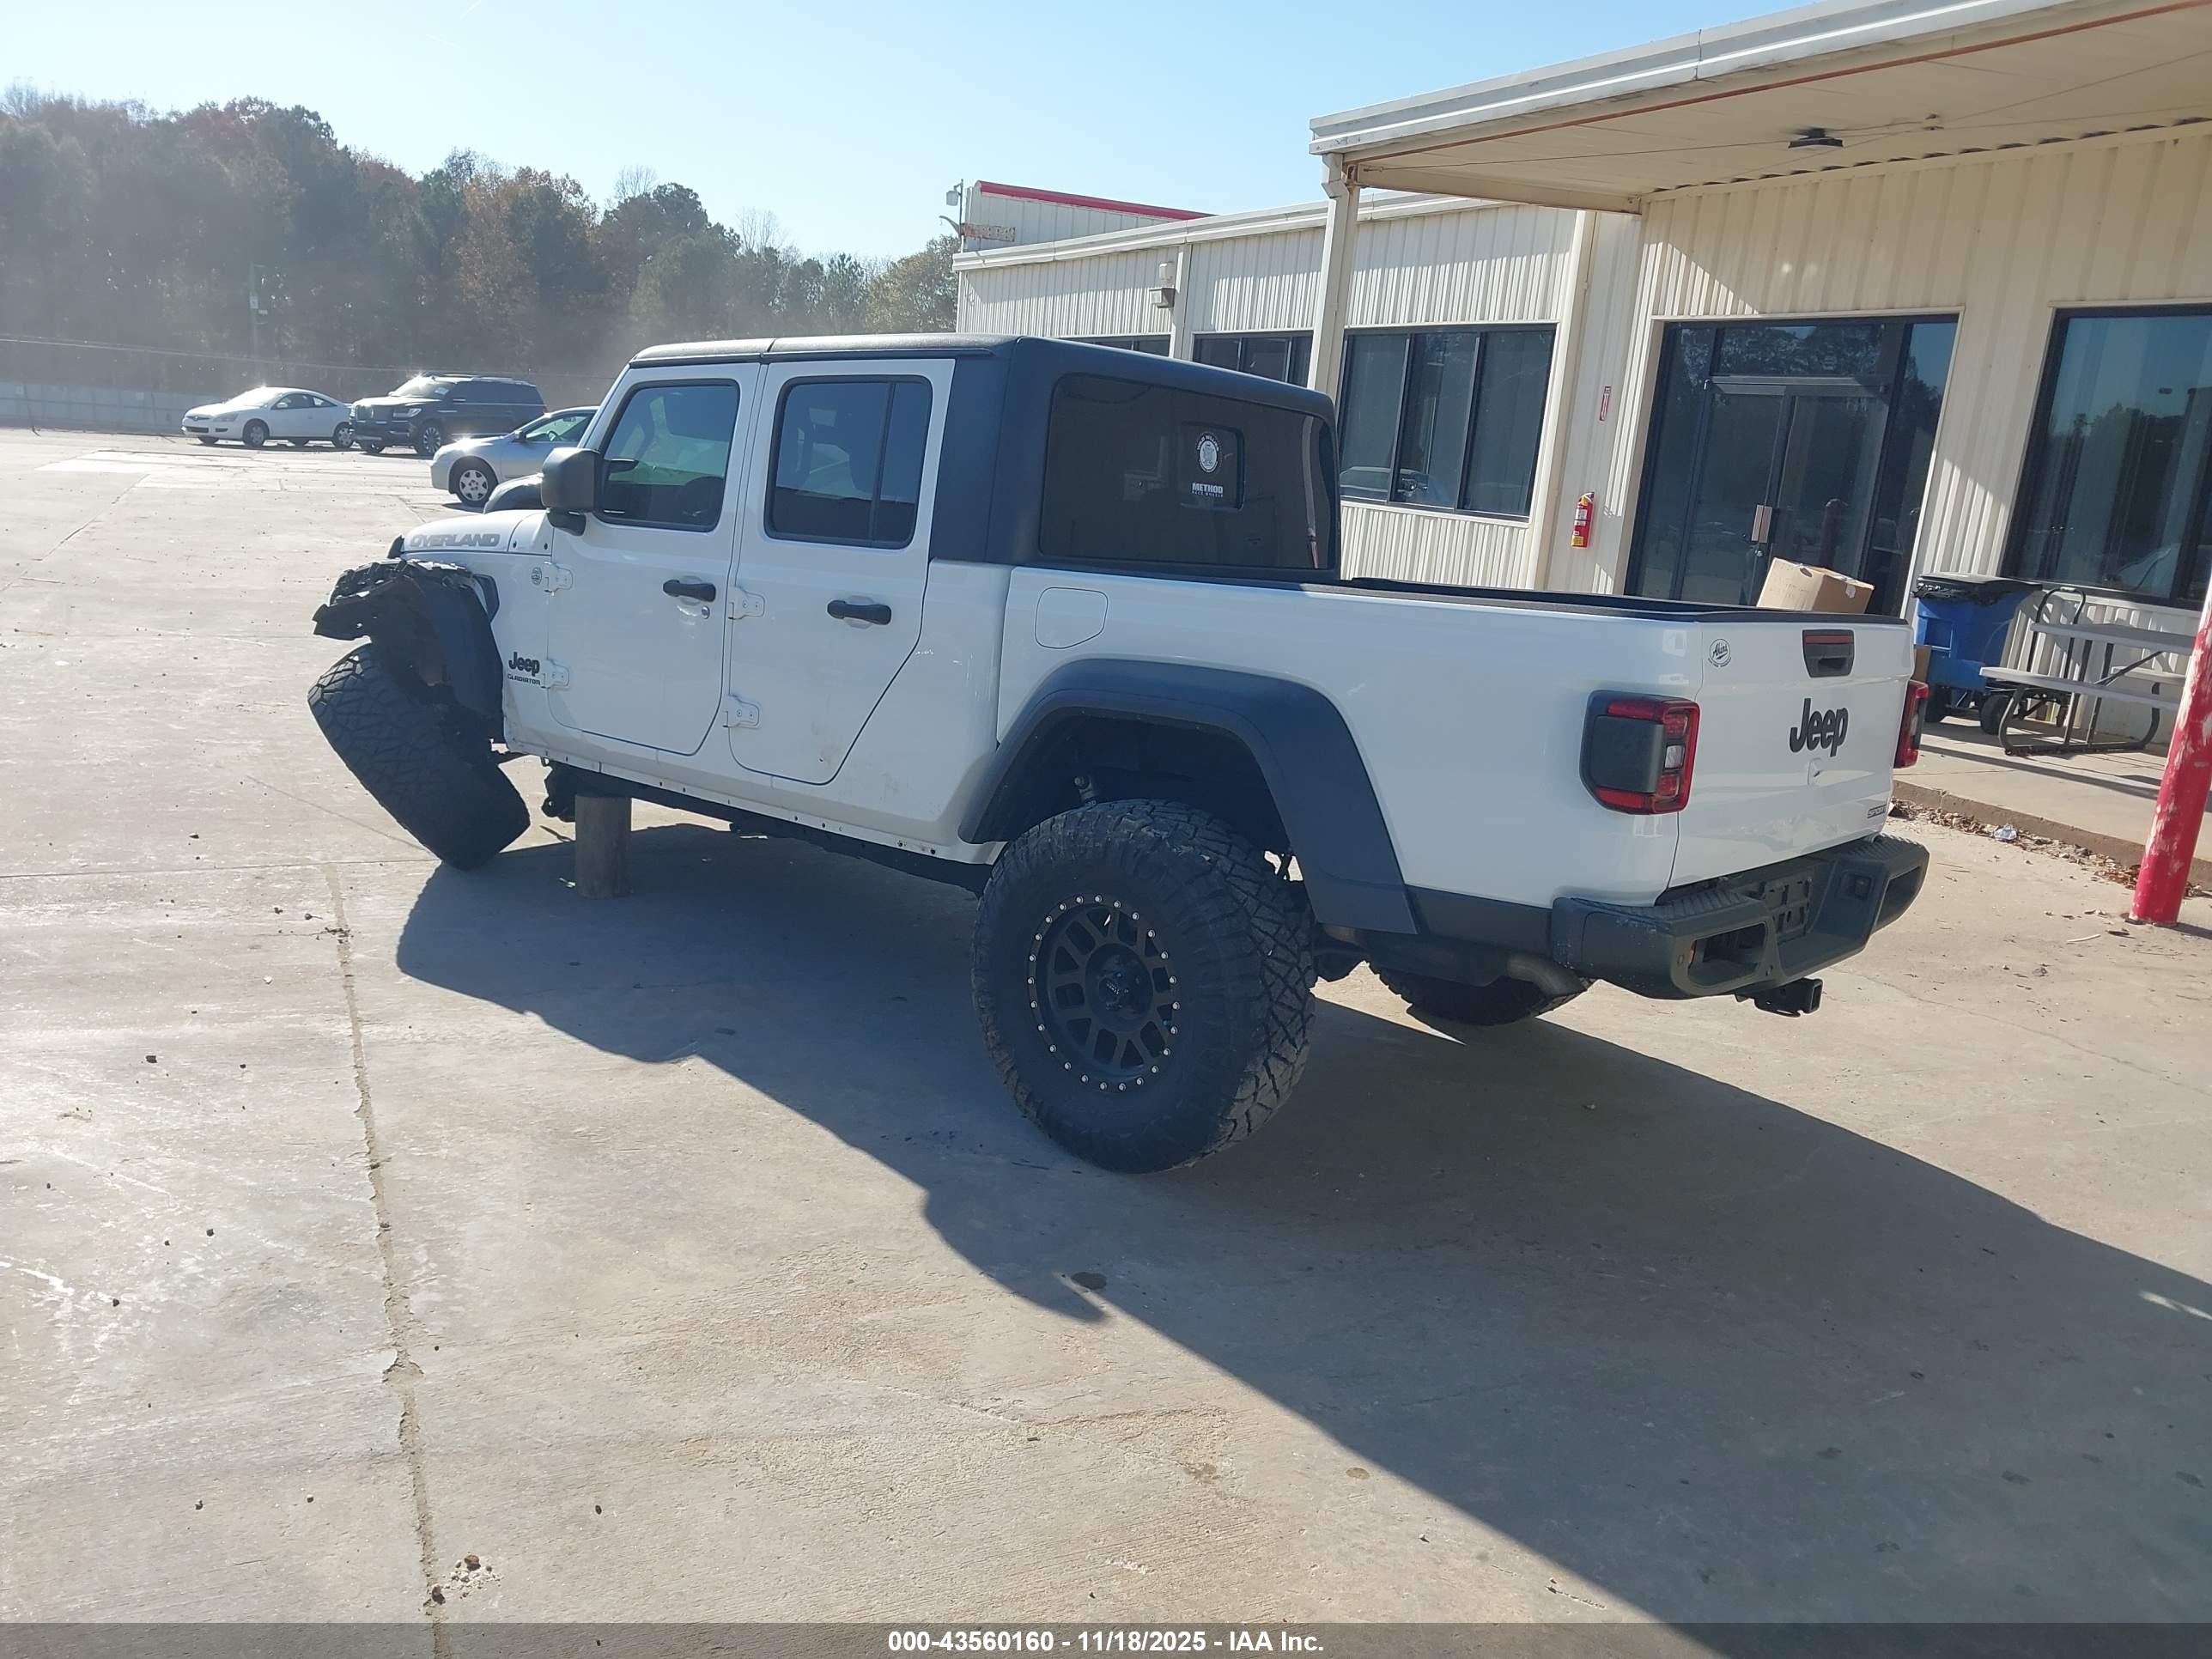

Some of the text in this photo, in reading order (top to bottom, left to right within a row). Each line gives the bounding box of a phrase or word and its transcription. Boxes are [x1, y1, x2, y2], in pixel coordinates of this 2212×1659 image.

[1192, 482, 1224, 494] METHOD
[410, 533, 501, 548] OVERLAND
[508, 651, 540, 678] Jeep
[507, 673, 541, 686] GLADIATOR
[1789, 697, 1849, 757] Jeep
